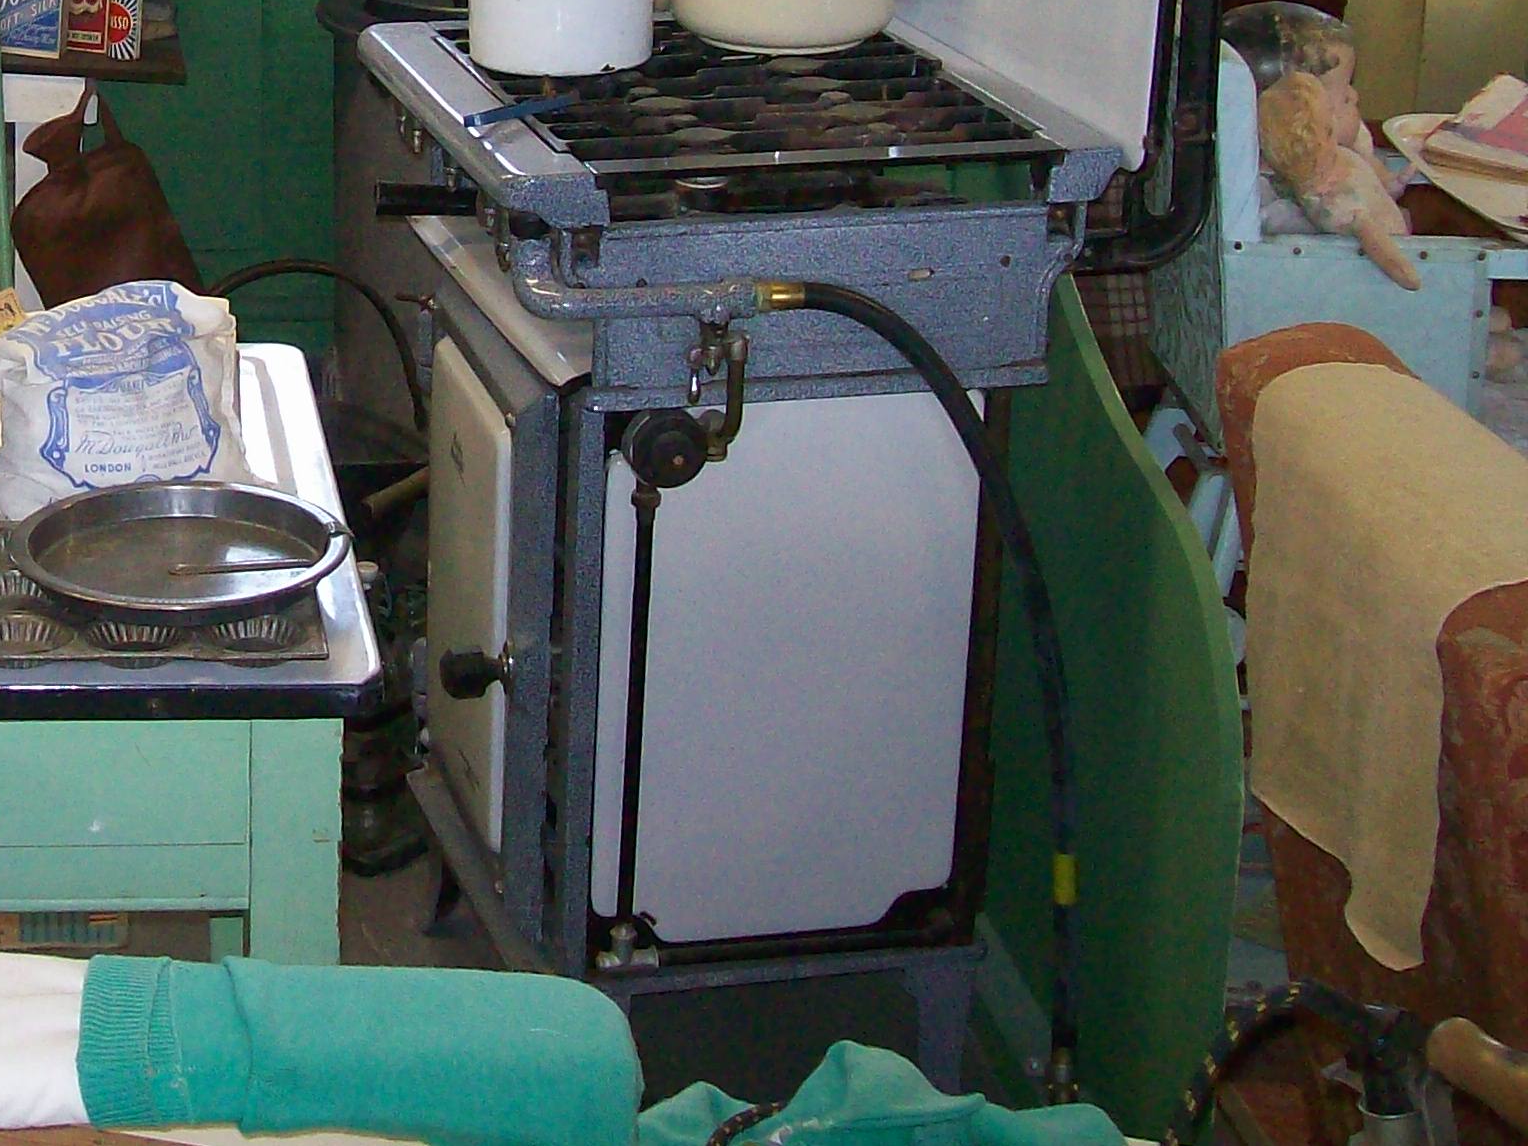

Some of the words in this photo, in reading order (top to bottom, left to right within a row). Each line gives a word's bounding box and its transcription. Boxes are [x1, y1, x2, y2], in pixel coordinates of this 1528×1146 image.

[0, 11, 21, 31] OFT
[93, 309, 152, 331] RAISING
[84, 463, 132, 473] LONDON
